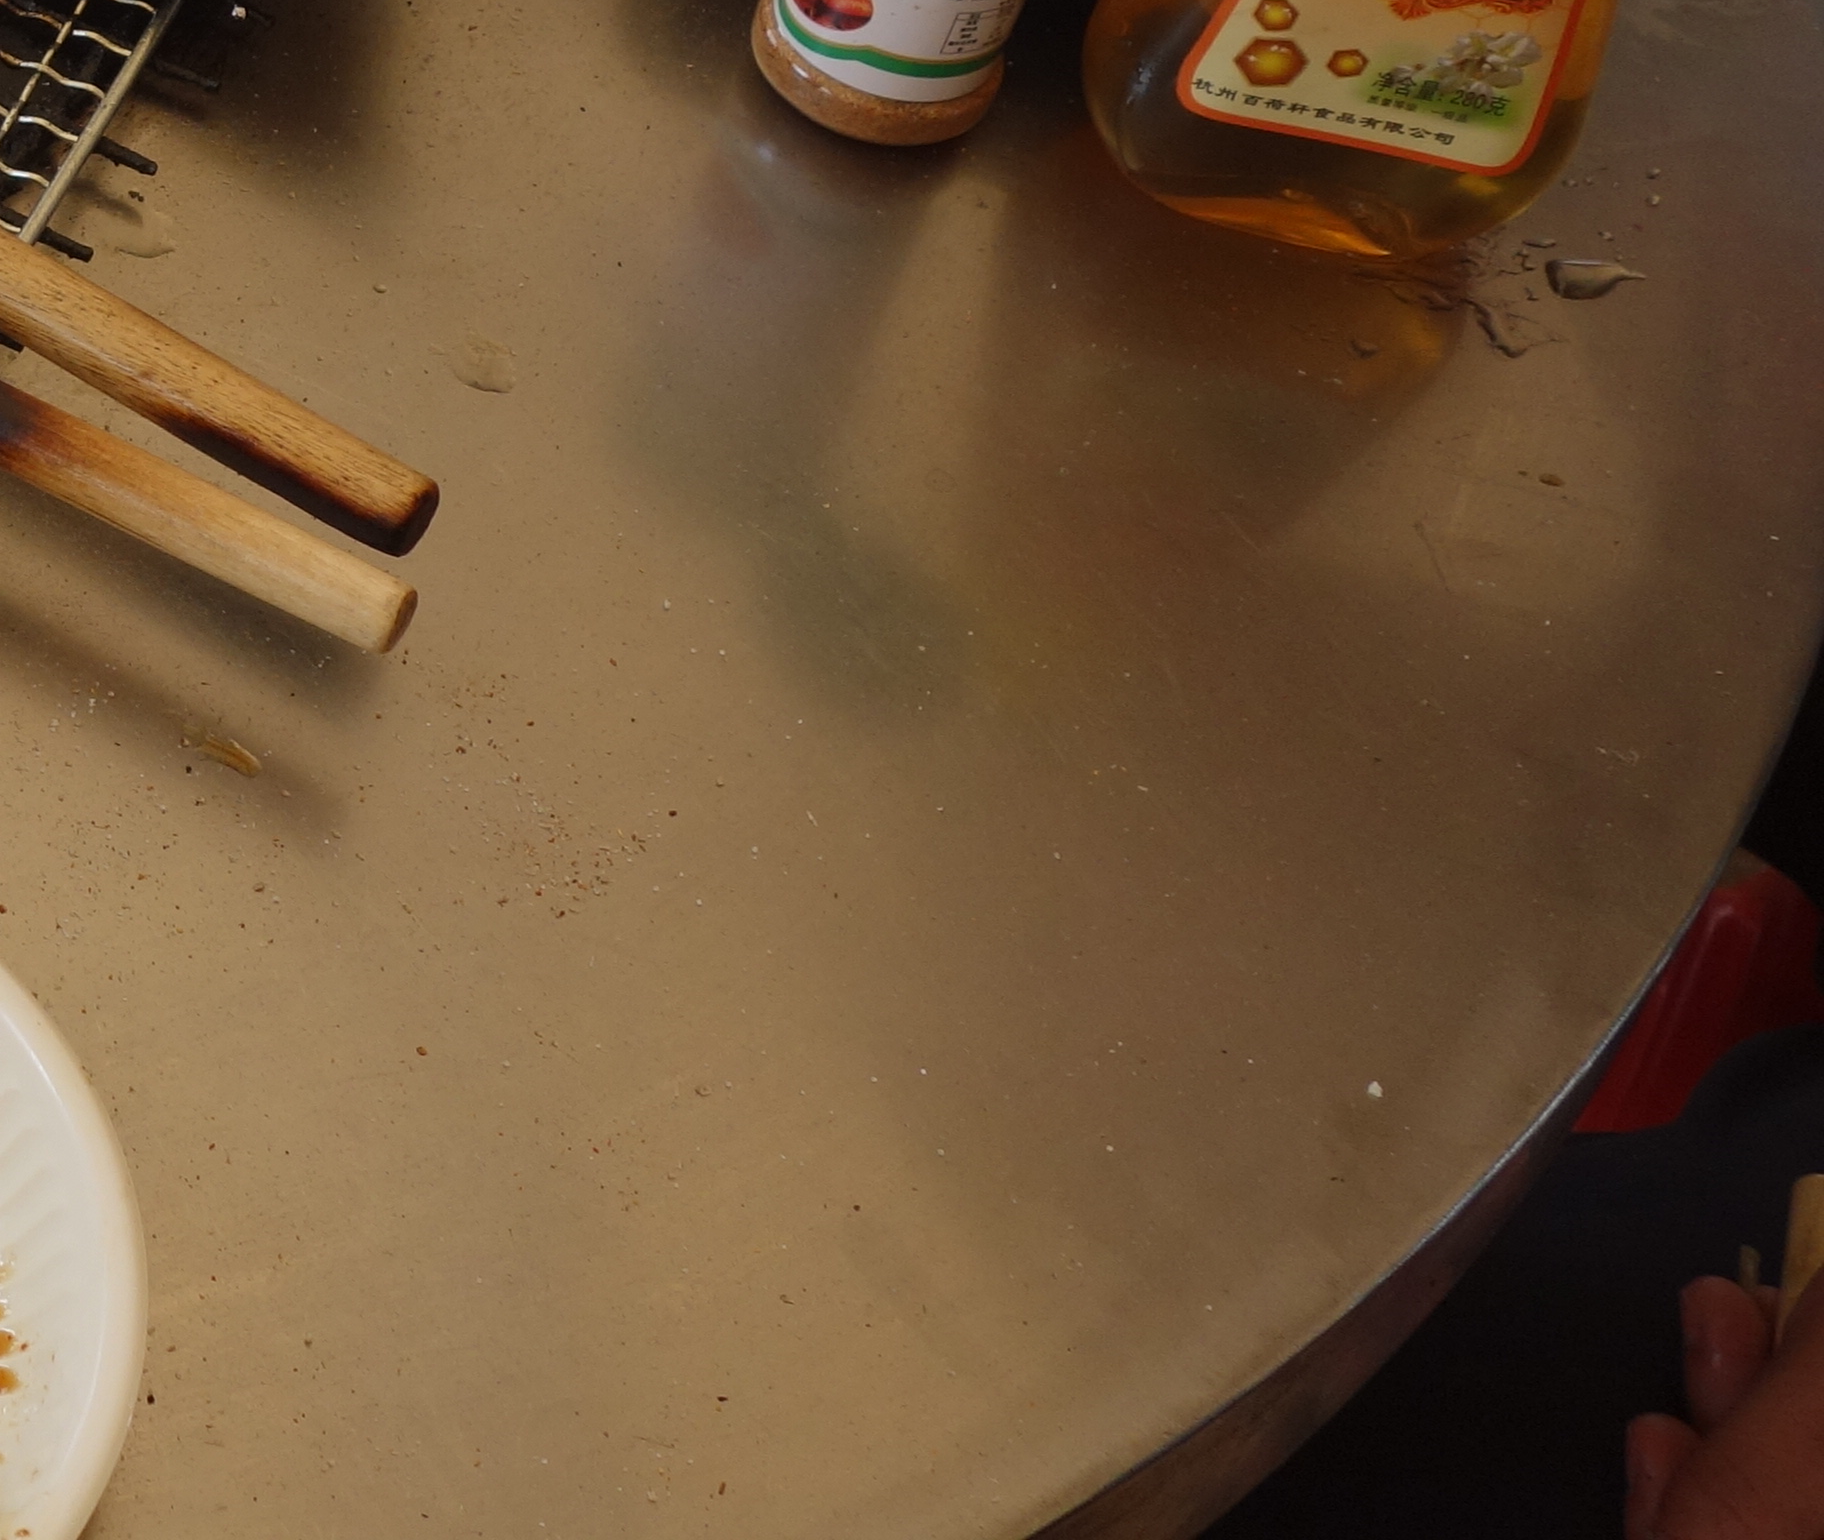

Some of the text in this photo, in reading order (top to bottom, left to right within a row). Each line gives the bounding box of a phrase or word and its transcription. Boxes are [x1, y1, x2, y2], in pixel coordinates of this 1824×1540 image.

[1193, 77, 1456, 146] 杭州百荷轩食品有限公司
